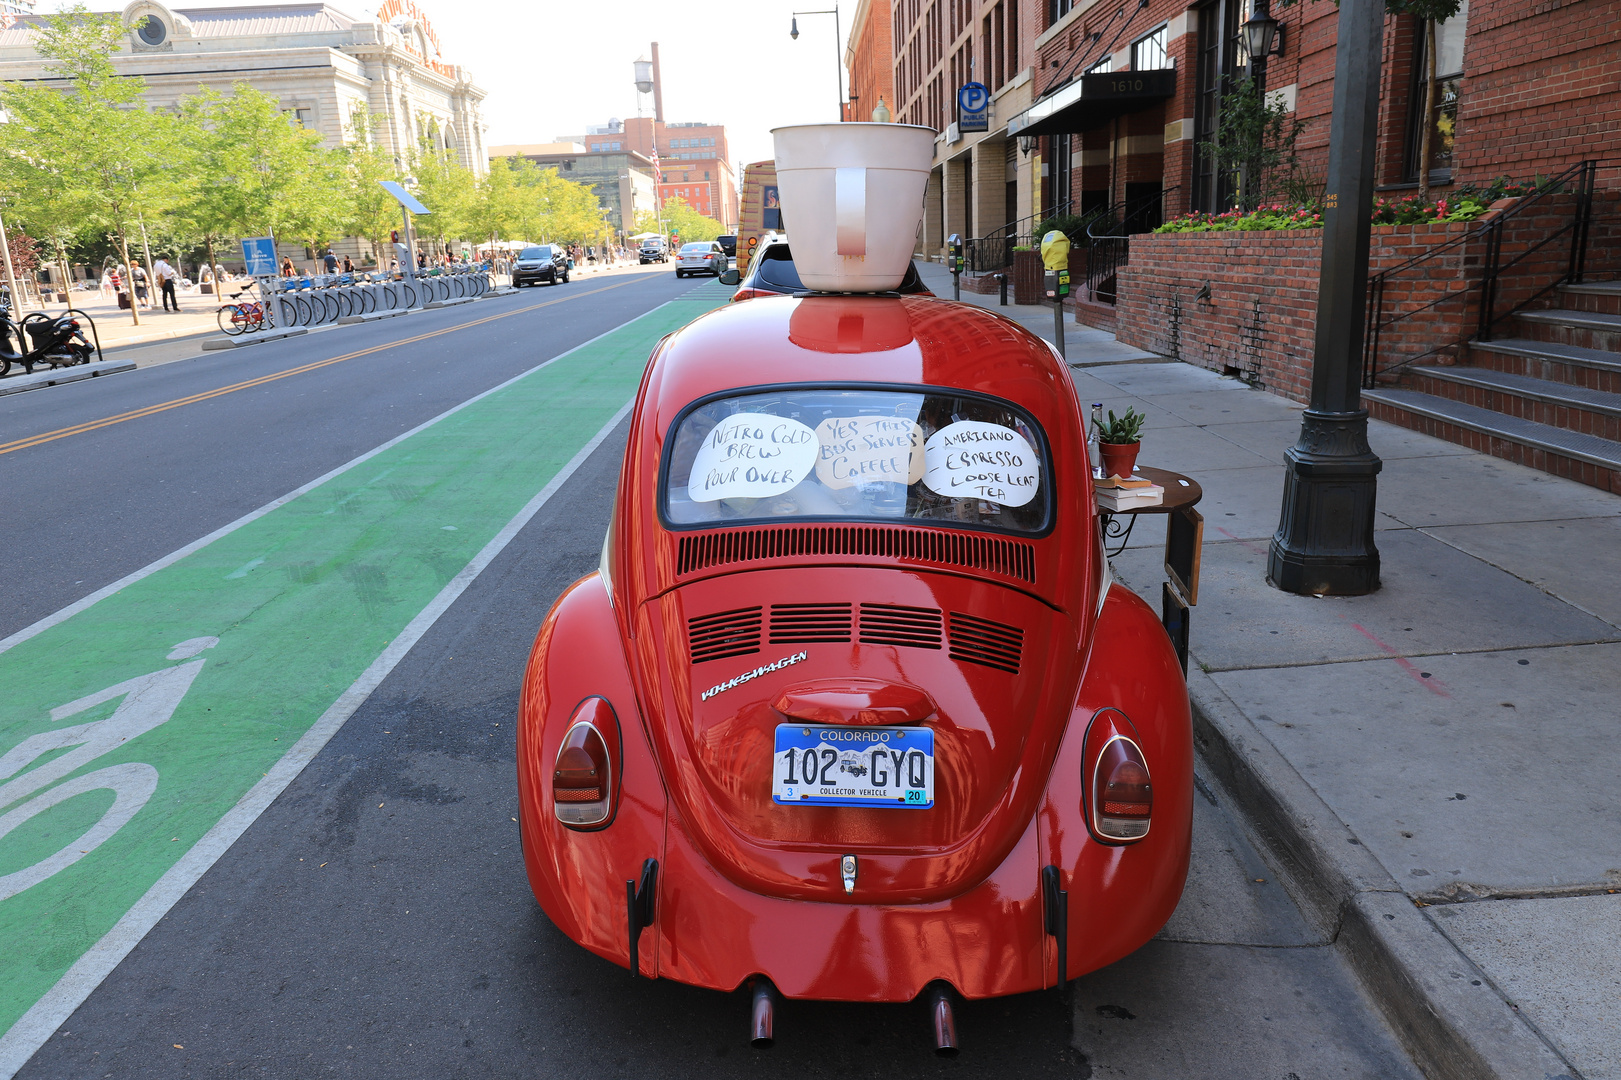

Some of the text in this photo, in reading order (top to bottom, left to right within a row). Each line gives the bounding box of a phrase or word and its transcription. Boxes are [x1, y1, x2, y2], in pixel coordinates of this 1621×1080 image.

[1111, 80, 1143, 92] 1610
[968, 88, 981, 107] P
[713, 423, 812, 449] NITRO COLD
[826, 419, 912, 439] YES THIS
[820, 432, 917, 460] BUG SERVES
[944, 431, 1014, 447] AMERICANO
[720, 443, 781, 463] BREW
[946, 451, 1023, 470] ESPRESSO
[705, 466, 795, 490] POUR OVER
[951, 473, 1035, 487] LOOSE LEAF
[974, 486, 1006, 500] TEA
[701, 650, 807, 702] VOLKSWAGEN
[819, 730, 890, 743] COLORADO
[783, 748, 926, 788] 102 GYQ
[786, 787, 794, 796] 3
[819, 787, 887, 797] COLLECTOR VEHICLE
[908, 790, 921, 801] 20
